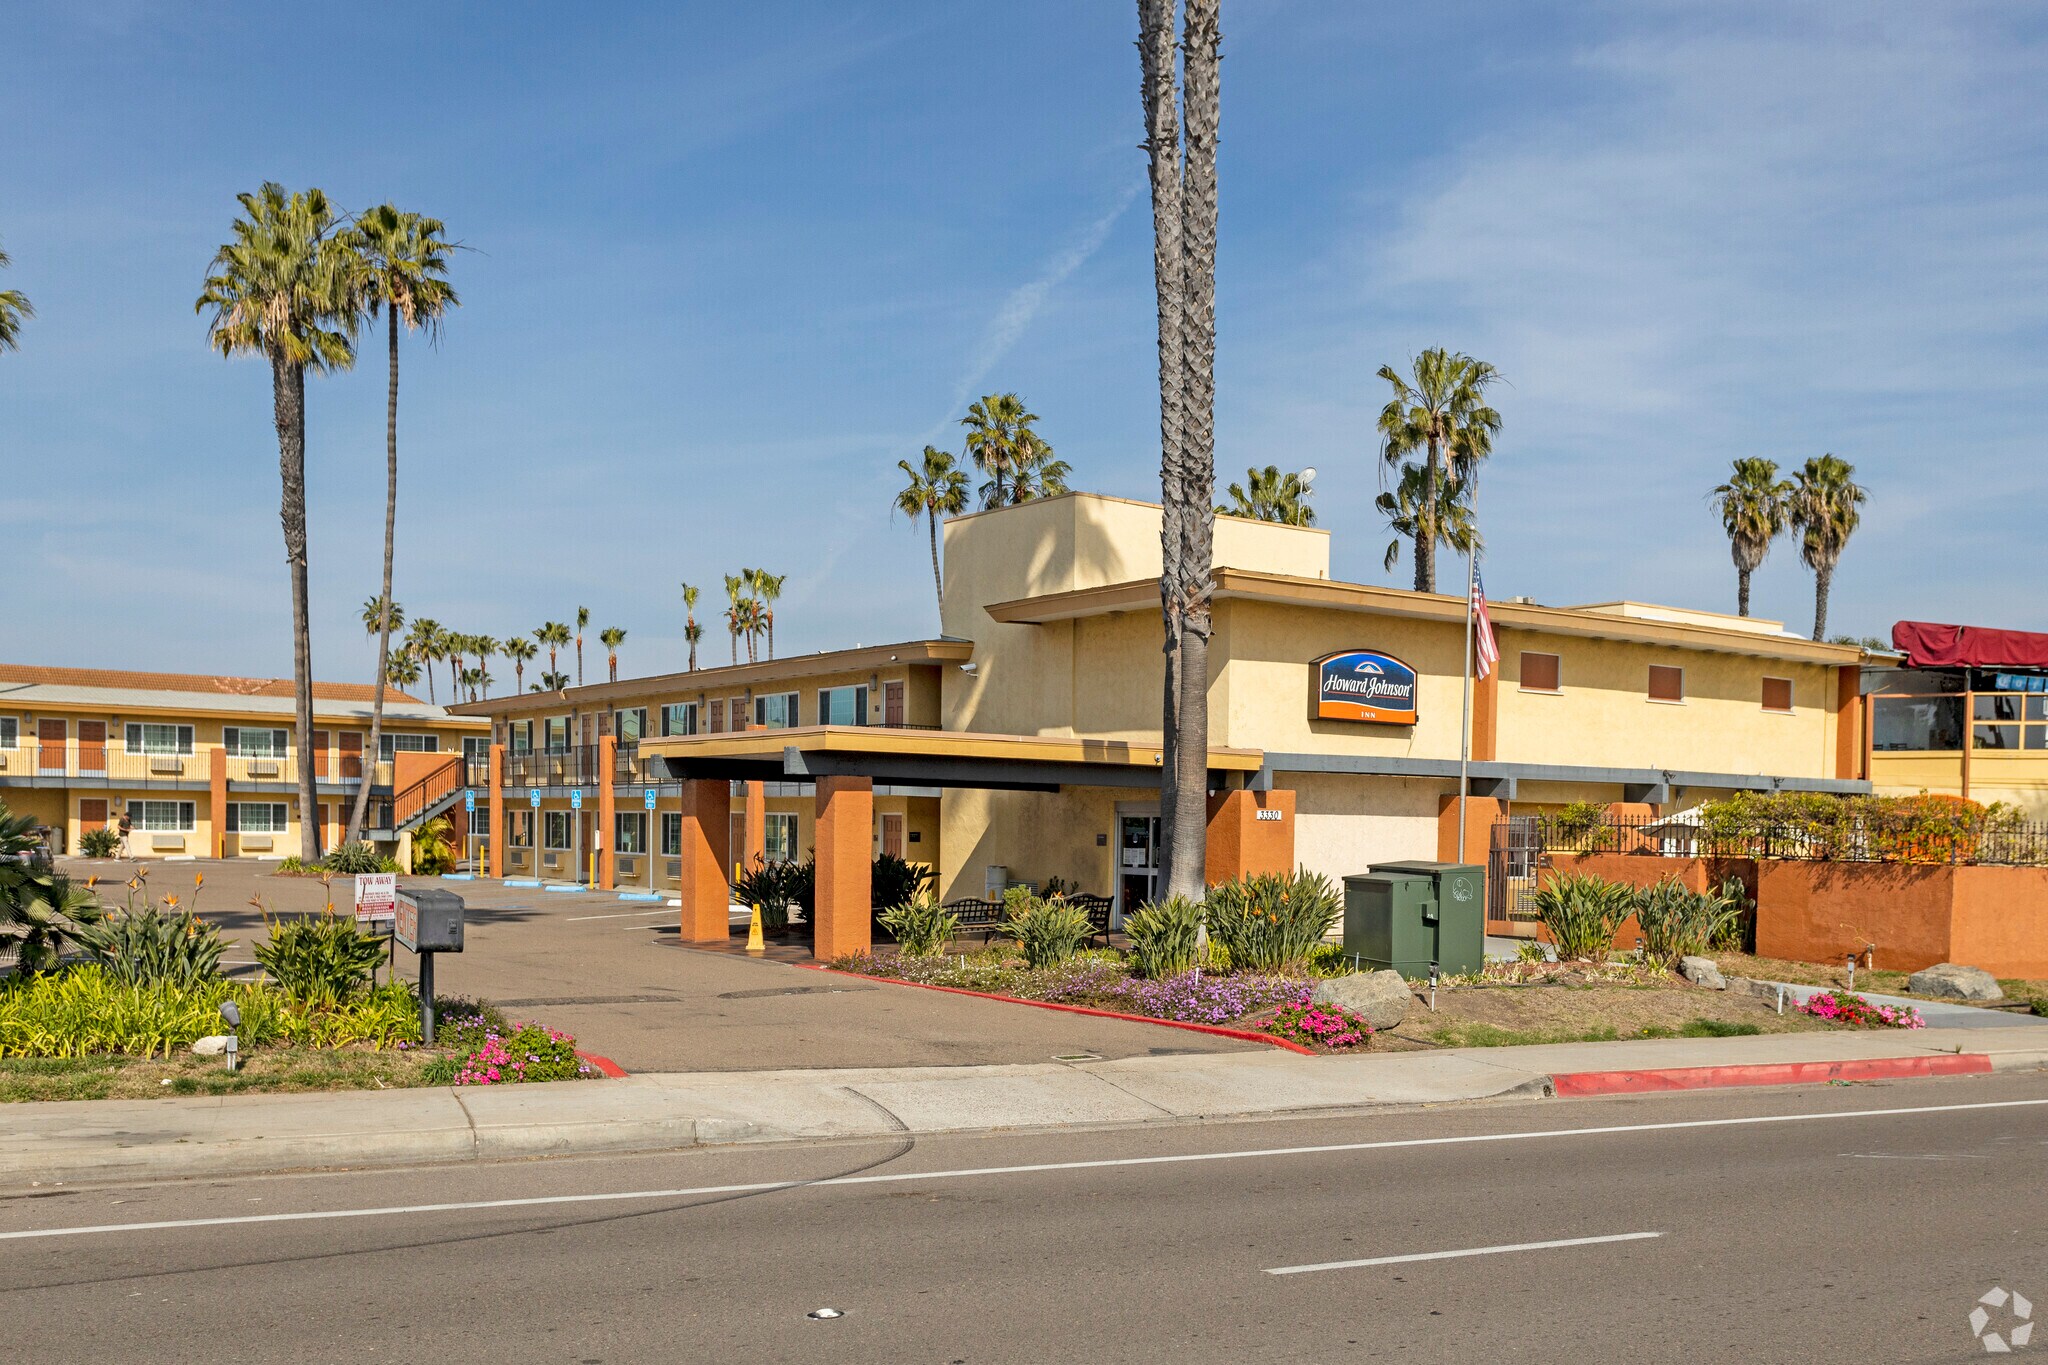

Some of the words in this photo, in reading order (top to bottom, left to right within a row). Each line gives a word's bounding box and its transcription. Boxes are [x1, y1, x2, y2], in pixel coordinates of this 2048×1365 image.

[1323, 674, 1368, 693] Howard
[1366, 677, 1412, 698] Johnson
[1361, 711, 1376, 719] INN
[1260, 810, 1279, 820] 3330
[359, 876, 373, 886] TOW
[375, 876, 393, 885] AWAY
